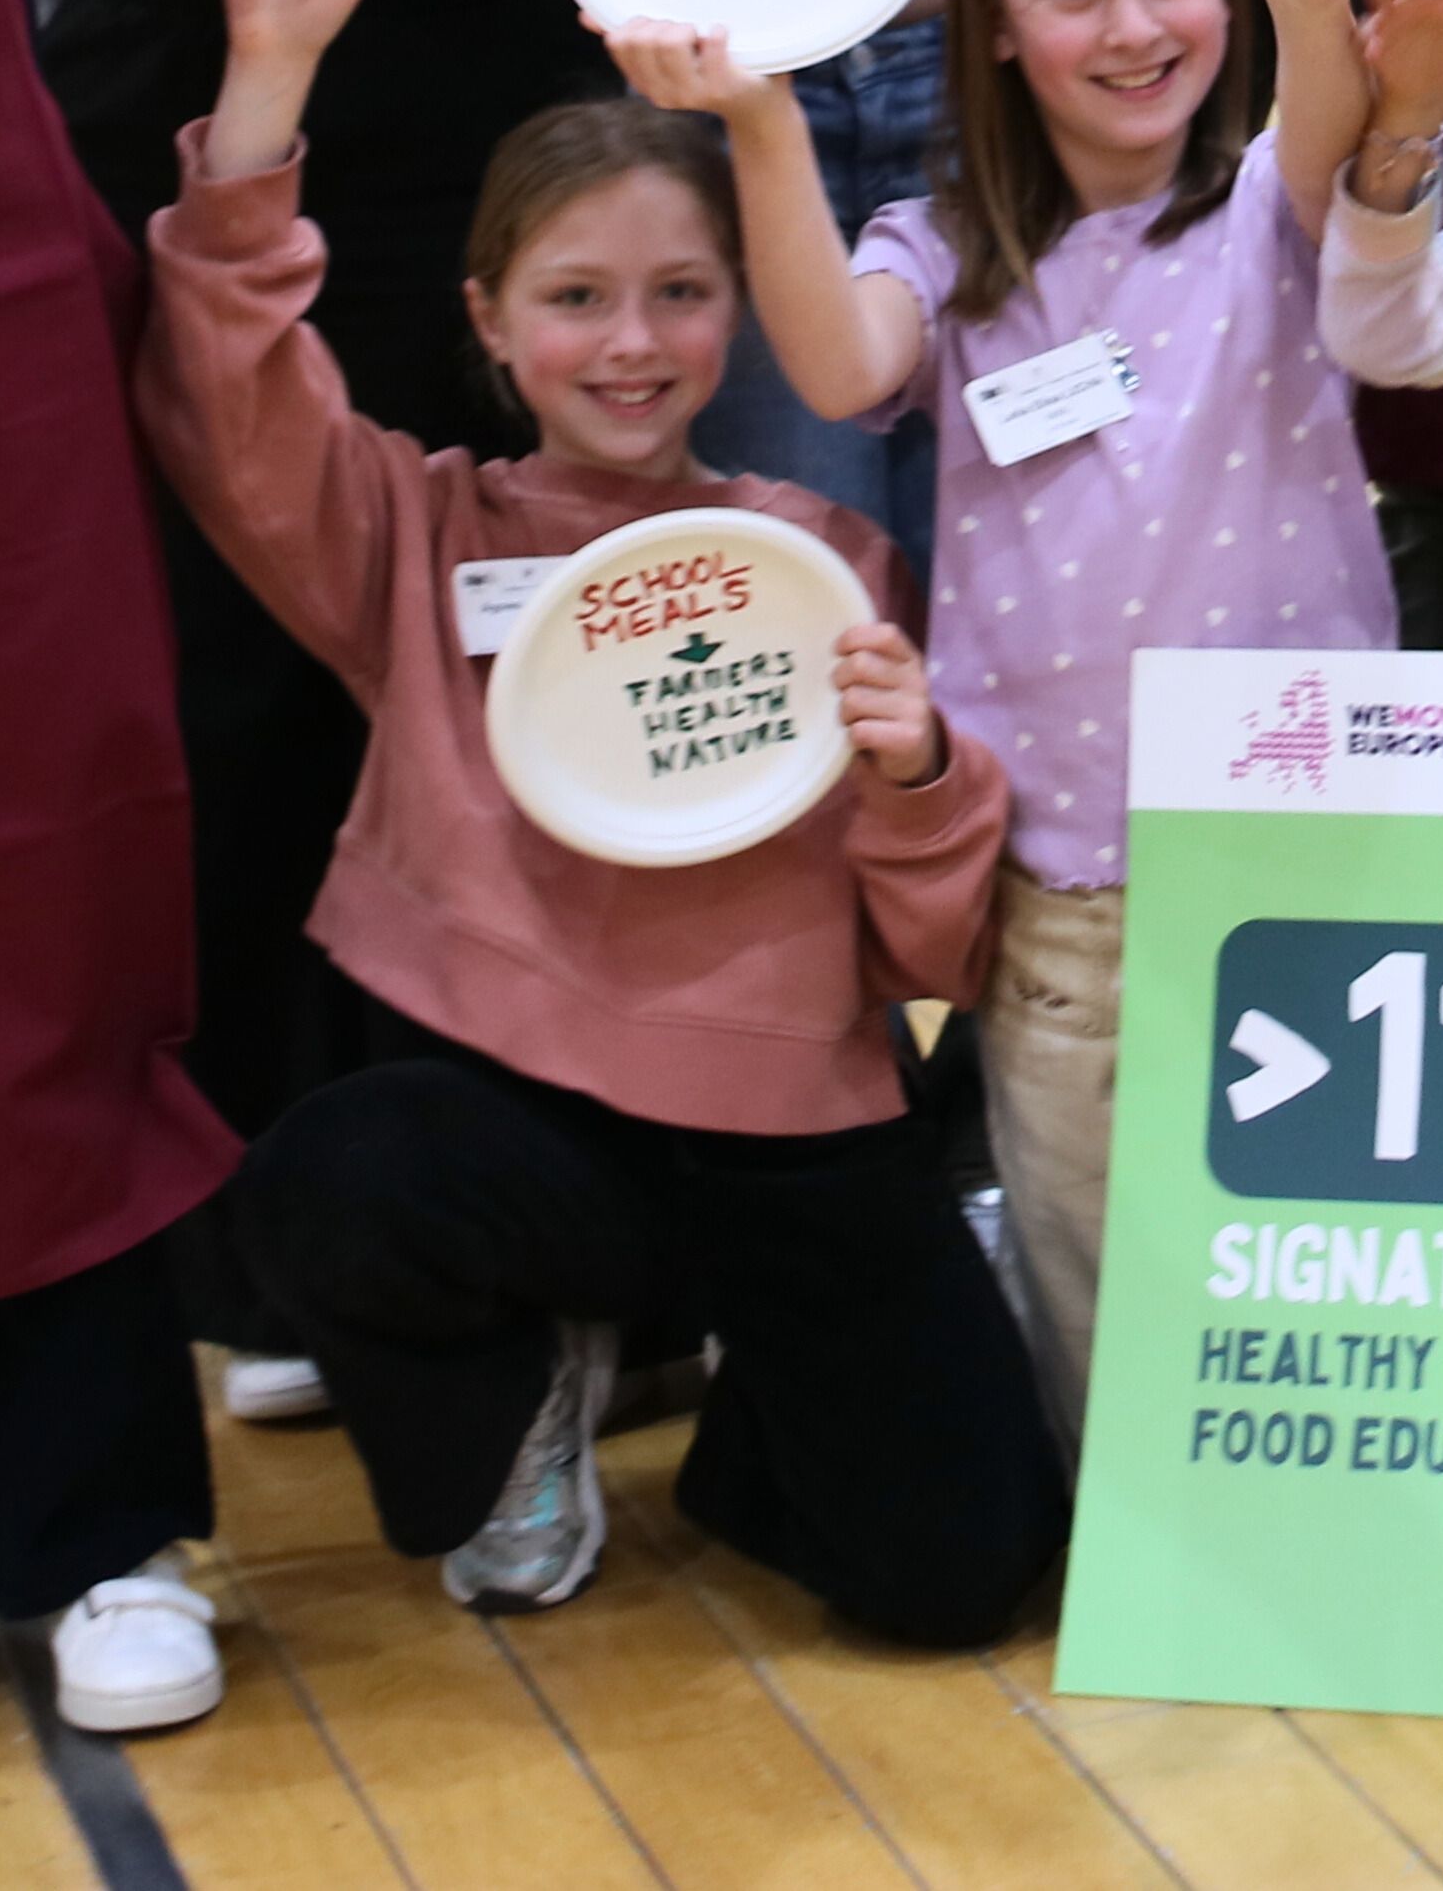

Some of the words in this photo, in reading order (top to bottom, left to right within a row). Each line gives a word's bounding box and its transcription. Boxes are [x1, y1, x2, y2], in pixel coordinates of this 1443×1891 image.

[575, 551, 754, 620] SCHOOL
[581, 578, 751, 652] MEALS
[644, 685, 789, 739] HEALTH
[647, 717, 798, 778] NATURE
[1198, 1328, 1438, 1391] HEALTHY
[1190, 1409, 1335, 1466] FOOD
